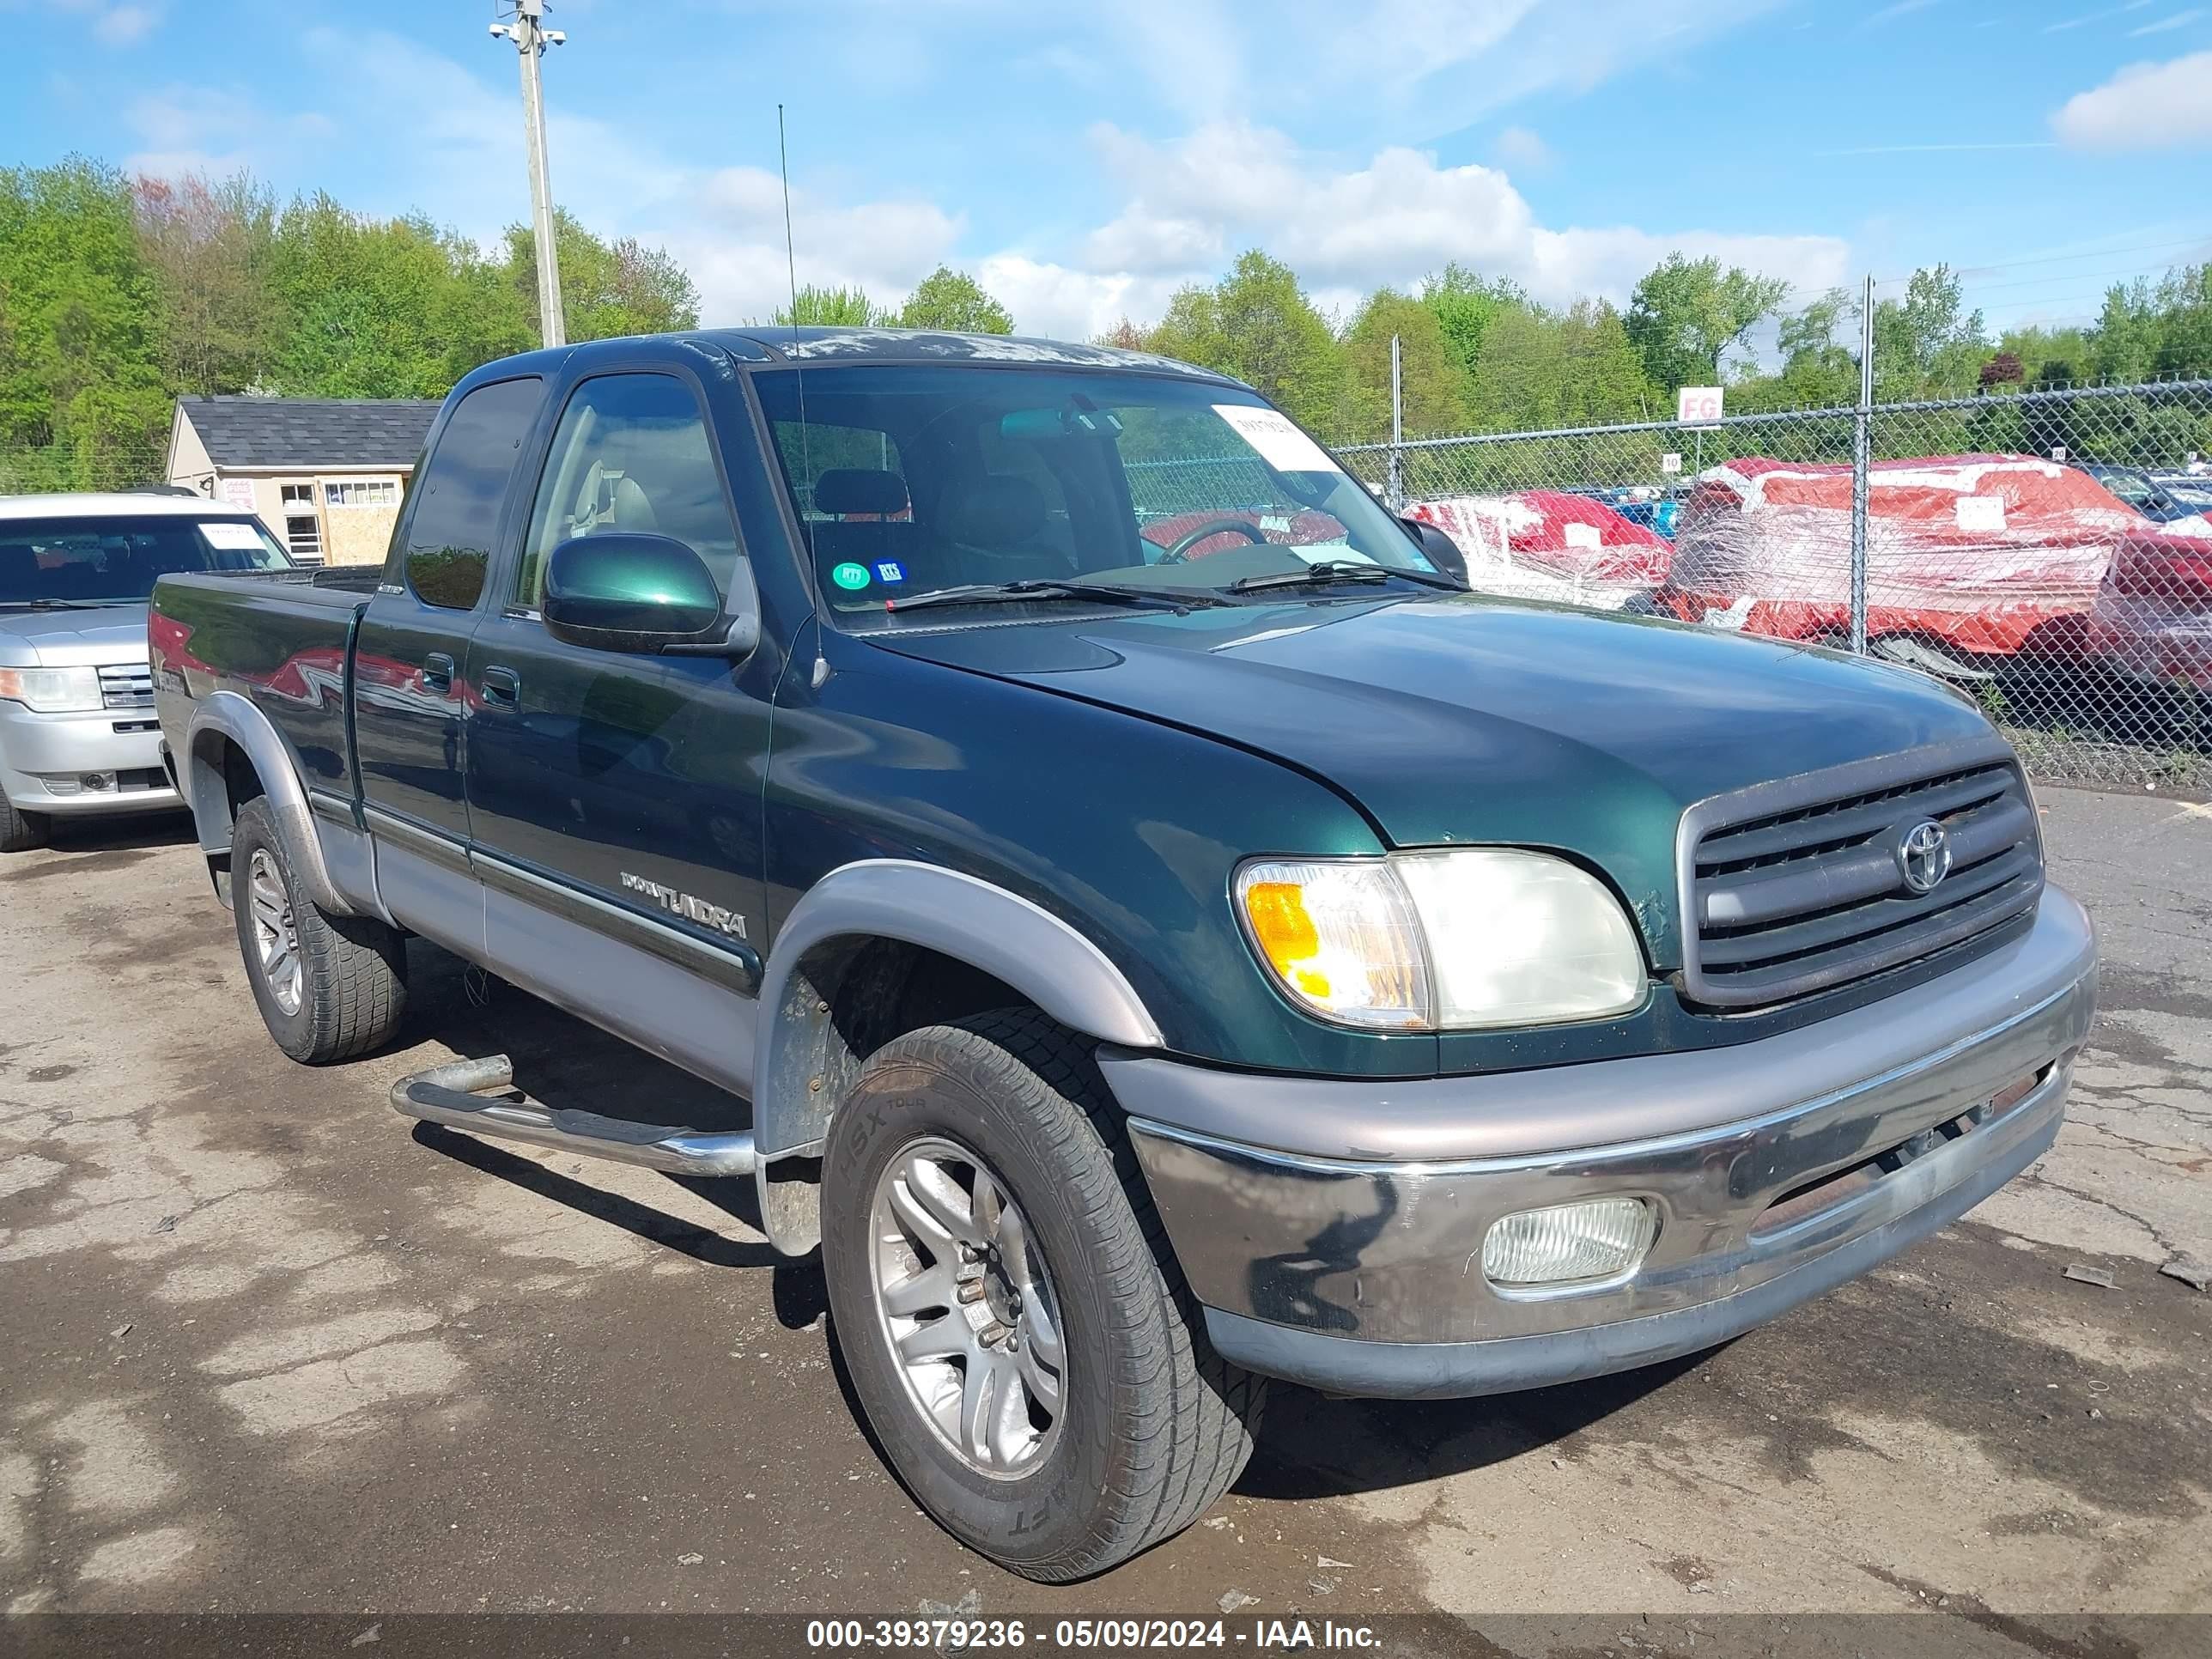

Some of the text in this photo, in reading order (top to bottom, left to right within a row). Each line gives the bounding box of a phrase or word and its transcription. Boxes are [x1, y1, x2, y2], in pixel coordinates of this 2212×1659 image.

[1684, 397, 1717, 420] FG
[1666, 458, 1678, 467] 10
[656, 884, 747, 939] TUNDRA
